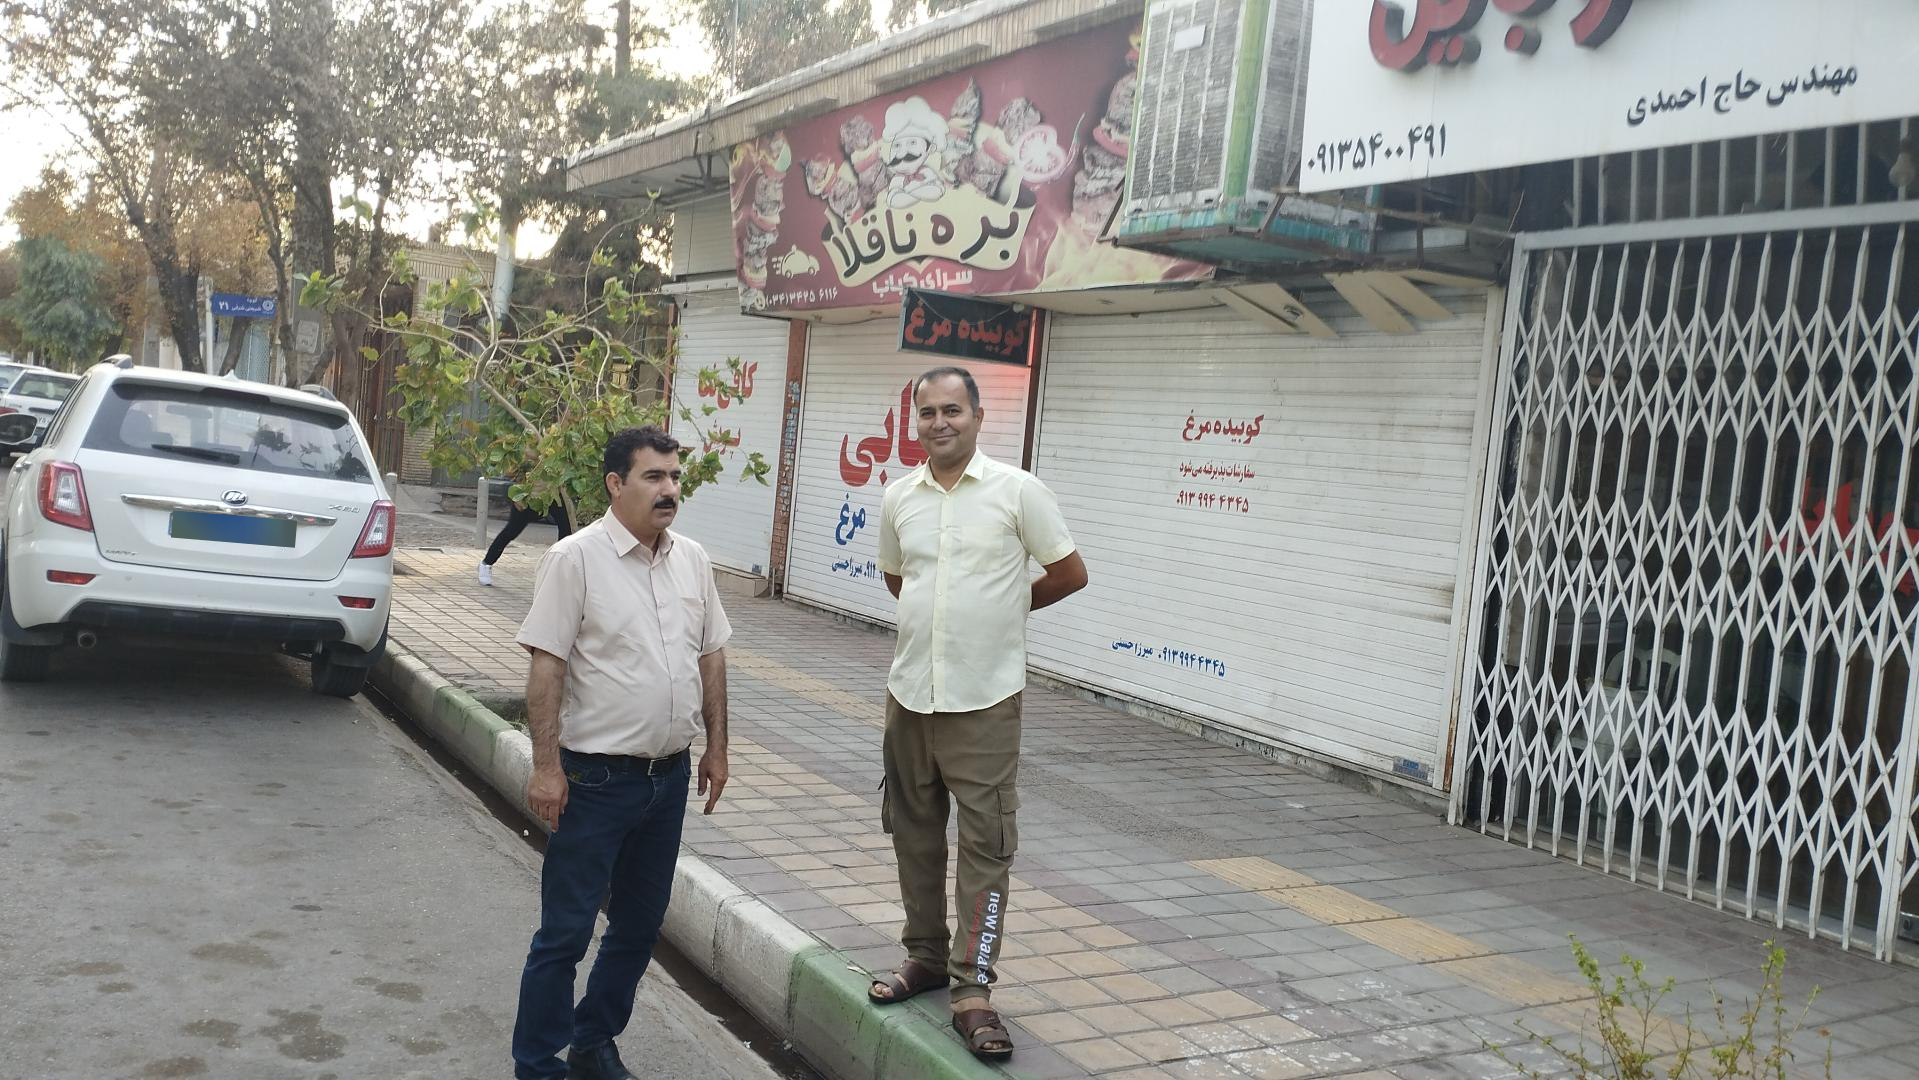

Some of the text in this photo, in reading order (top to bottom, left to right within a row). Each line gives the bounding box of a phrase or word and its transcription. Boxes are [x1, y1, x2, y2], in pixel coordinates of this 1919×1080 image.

[1626, 63, 1858, 126] مهندس حاج احمدی
[1308, 122, 1447, 174] ۰۹۱۳۵۴۰۰۴۹۱
[832, 209, 917, 279] ناقلا
[218, 300, 230, 311] ۲۱
[872, 267, 973, 299] سرای کباب
[904, 299, 1028, 355] کوبیده مرغ
[1182, 408, 1265, 445] کوبیده مرغ
[1226, 462, 1256, 483] سفارشات
[835, 491, 866, 546] مرغ
[984, 891, 1001, 931] new
